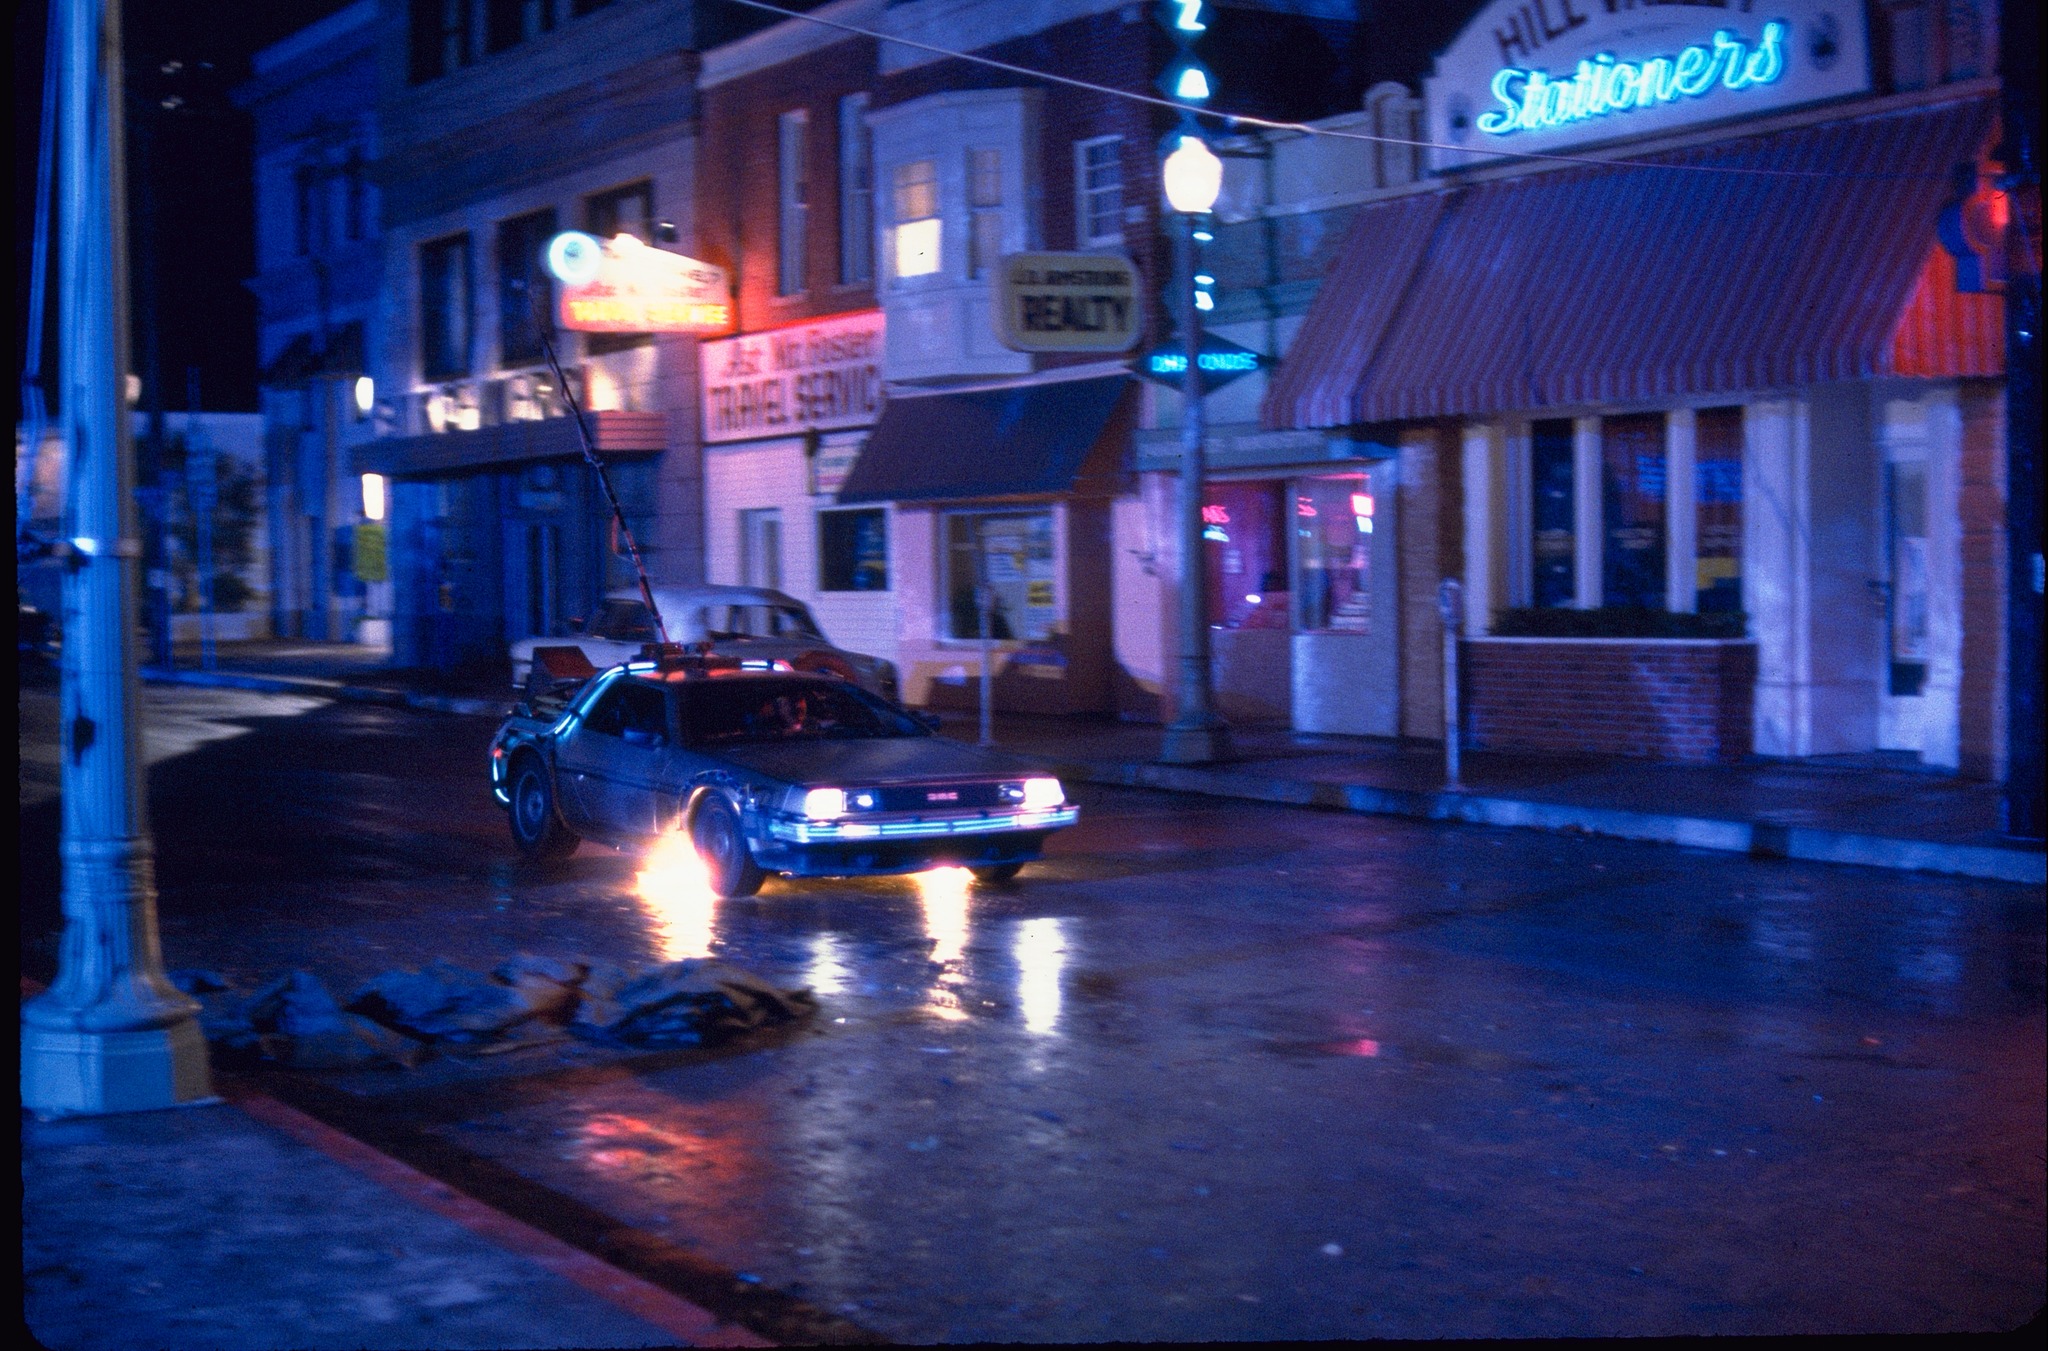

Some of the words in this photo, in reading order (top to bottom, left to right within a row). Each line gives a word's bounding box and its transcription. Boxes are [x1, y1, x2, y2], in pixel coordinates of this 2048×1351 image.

[1494, 0, 1588, 65] HILL
[1476, 20, 1787, 134] Stationers
[1020, 295, 1131, 331] REALTY
[708, 377, 787, 432] TRAVEL
[795, 364, 885, 423] SERVIC
